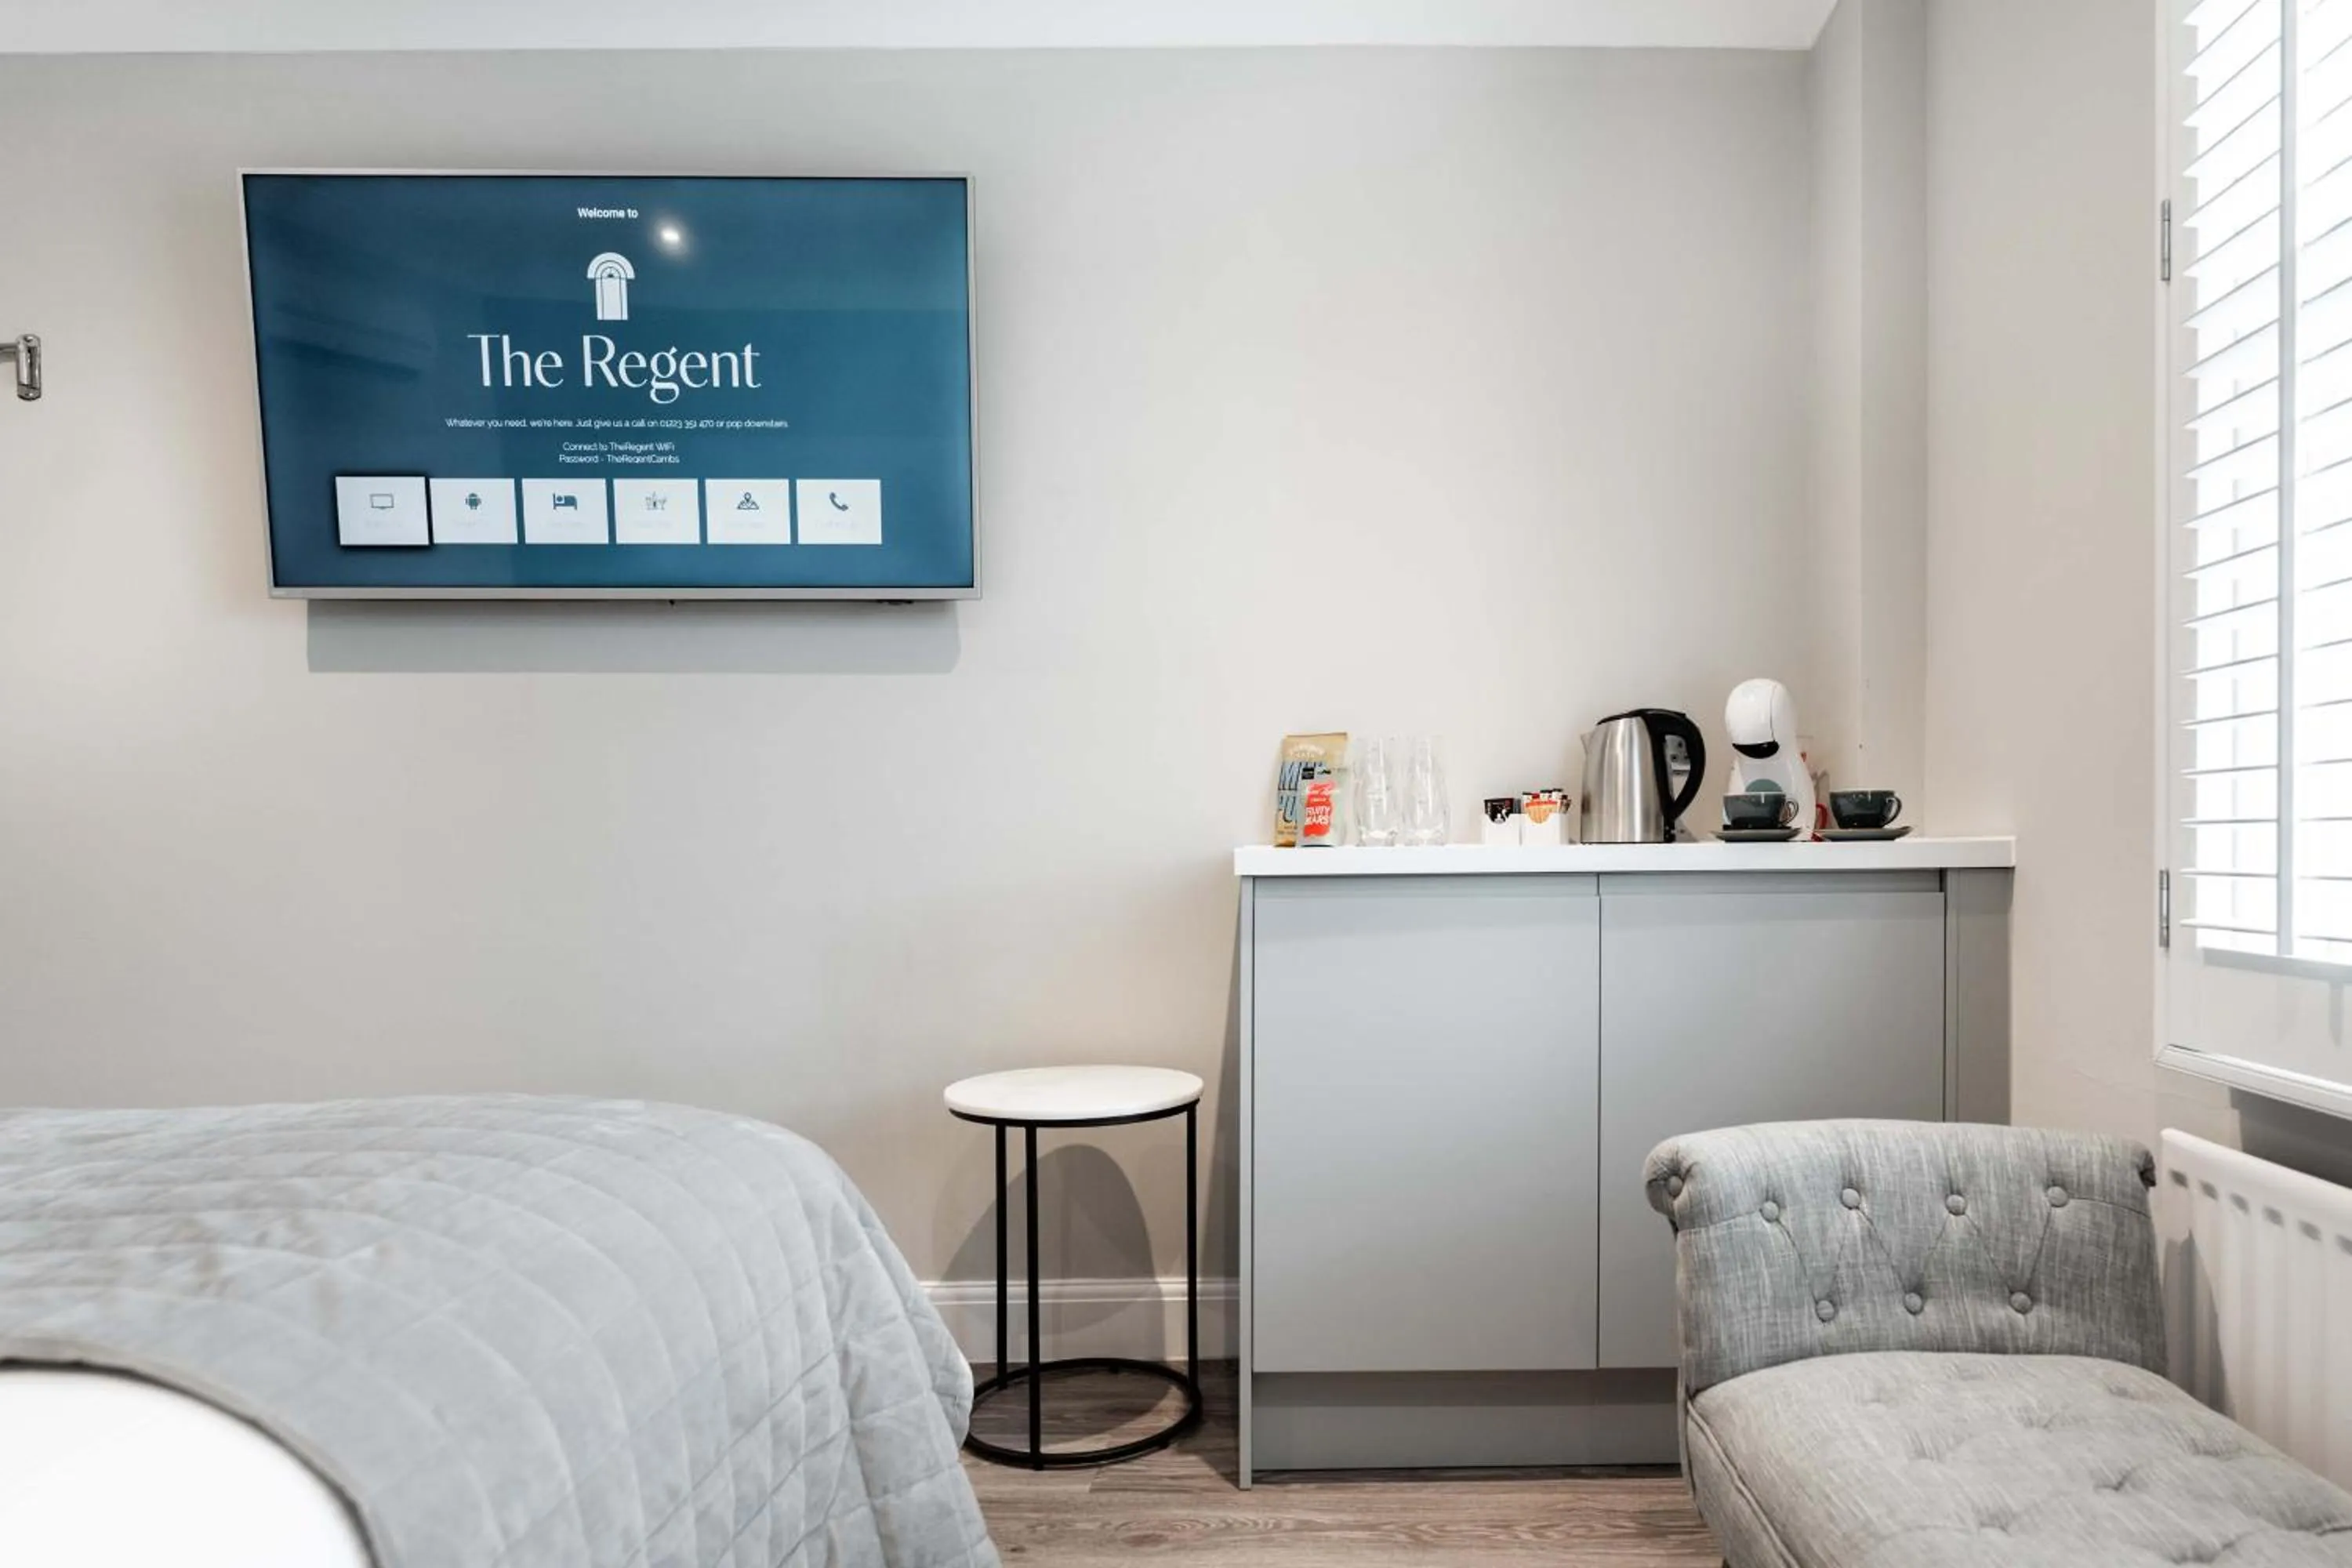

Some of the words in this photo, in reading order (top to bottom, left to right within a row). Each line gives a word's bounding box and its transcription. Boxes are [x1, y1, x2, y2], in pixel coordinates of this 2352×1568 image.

[577, 207, 625, 219] Welcome
[627, 208, 639, 219] to
[466, 334, 564, 387] The
[583, 335, 760, 405] Regent
[445, 418, 485, 427] Whatever
[487, 419, 503, 429] you
[575, 419, 592, 427] Just
[593, 419, 612, 430] give
[631, 419, 647, 427] call
[659, 419, 683, 429] 01223
[683, 419, 697, 429] 351
[725, 419, 743, 430] pop
[562, 441, 597, 451] Connect
[598, 442, 608, 451] to
[609, 441, 654, 453] TheRegent
[655, 441, 675, 451] WiFi
[558, 454, 599, 463] Password
[606, 454, 680, 464] TheRegentCambs
